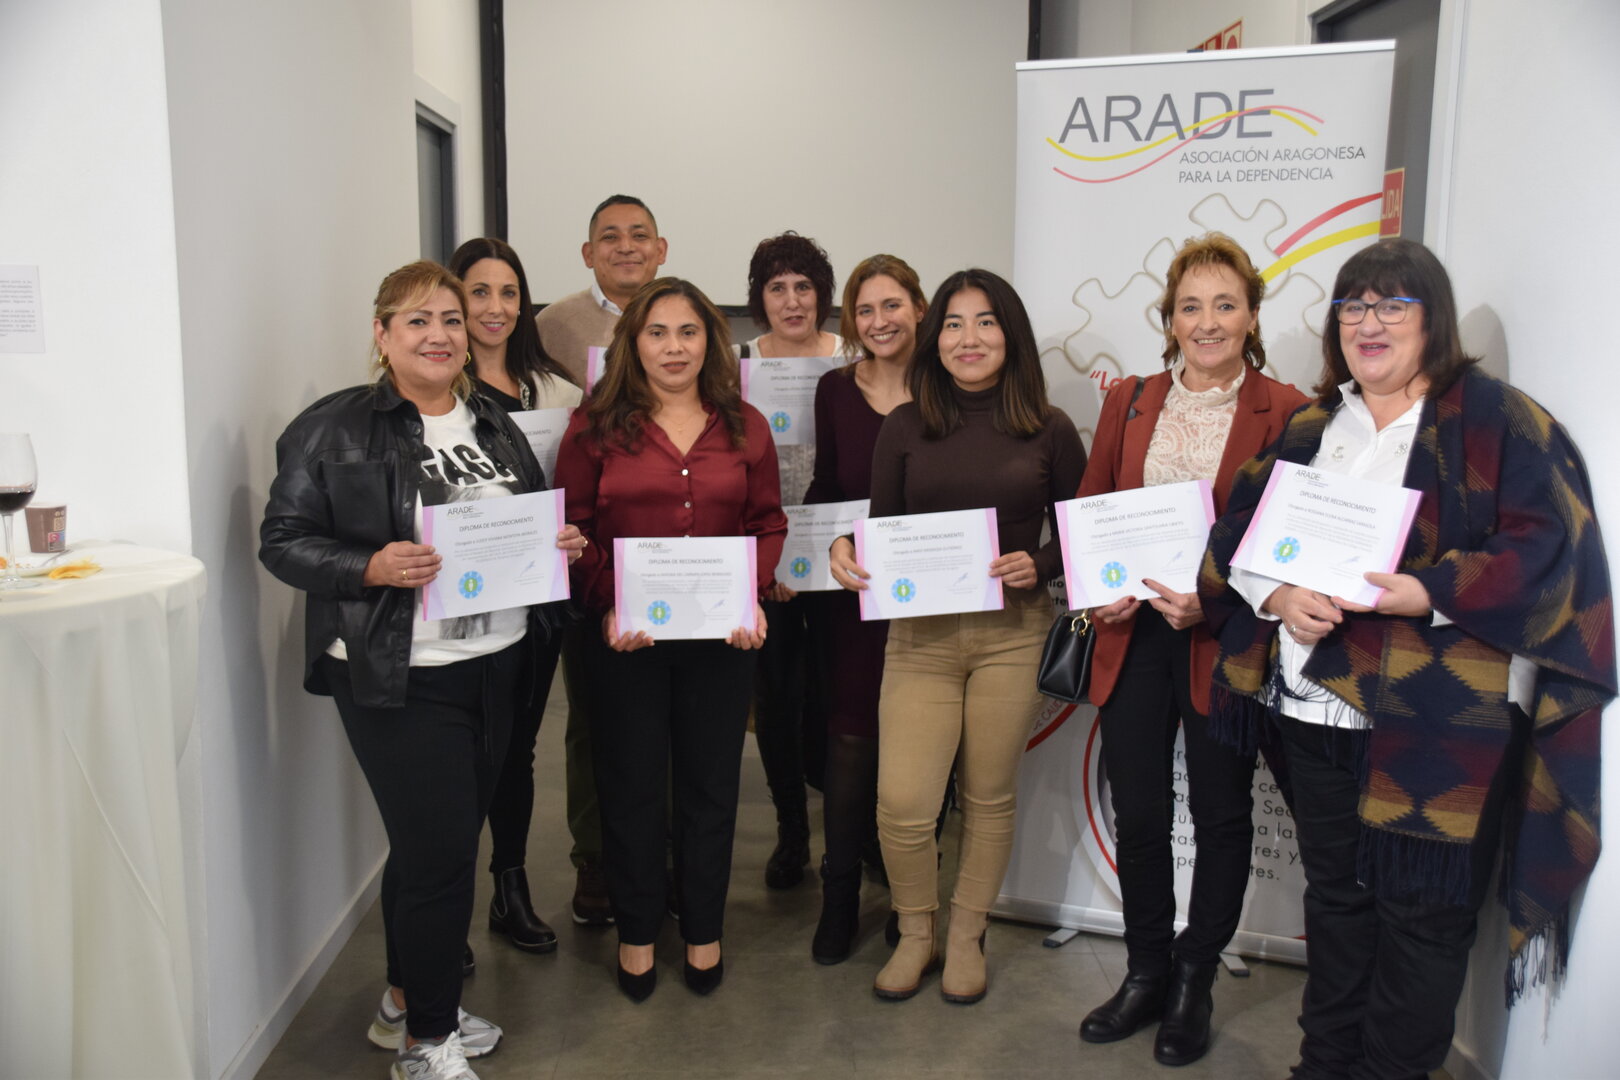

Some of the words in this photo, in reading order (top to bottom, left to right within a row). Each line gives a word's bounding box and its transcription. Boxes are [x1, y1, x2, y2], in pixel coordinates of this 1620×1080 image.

[1058, 88, 1274, 144] ARADE
[1179, 146, 1269, 164] ASOCIACIÓN
[1272, 146, 1366, 161] ARAGONESA
[1178, 170, 1213, 183] PARA
[1216, 169, 1232, 182] LA
[1236, 167, 1334, 182] DEPENDENCIA
[447, 505, 474, 516] ARADE
